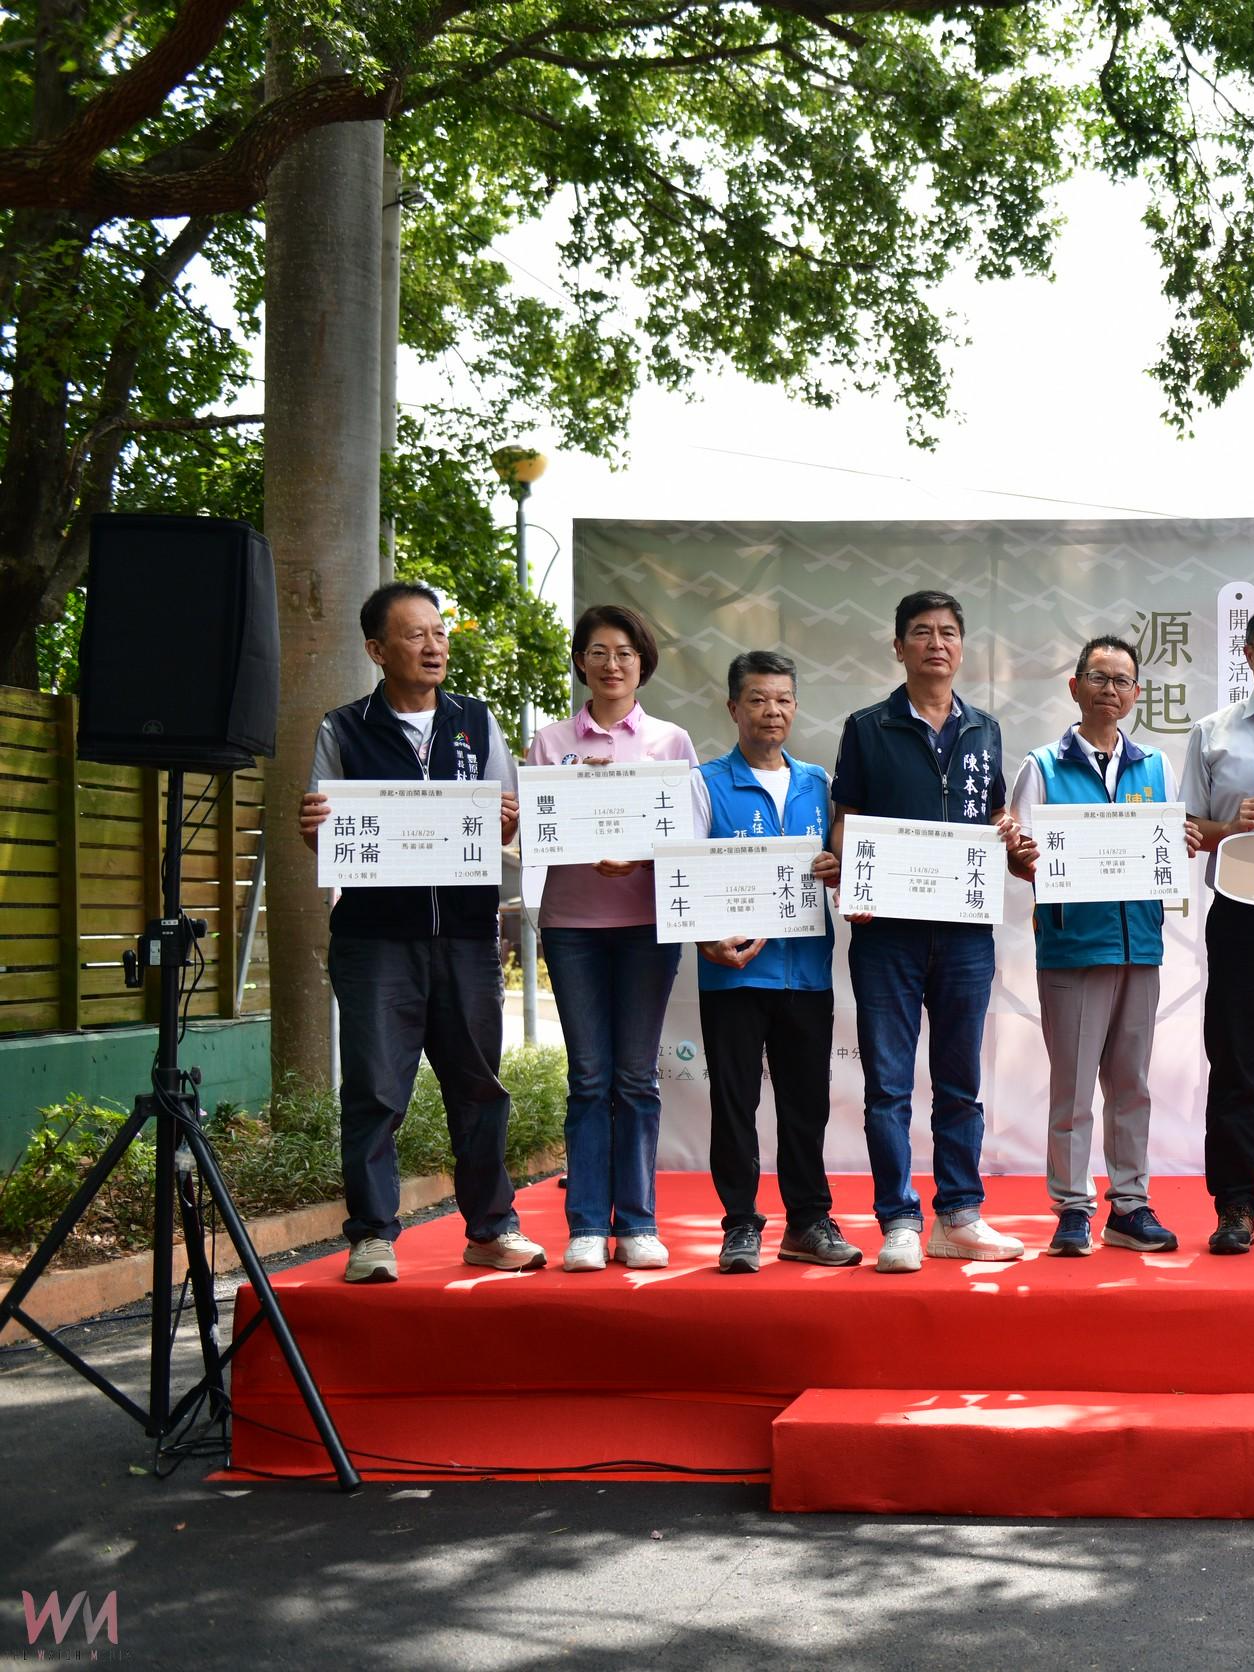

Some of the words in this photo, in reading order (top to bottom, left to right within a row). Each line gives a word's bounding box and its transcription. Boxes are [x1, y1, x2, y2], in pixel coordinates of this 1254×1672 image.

[1131, 611, 1192, 735] 源起
[1228, 609, 1249, 703] 開幕活動
[963, 753, 980, 818] 陳本添
[980, 749, 991, 816] 臺中市議員
[462, 815, 484, 863] 新山
[537, 795, 558, 843] 豐原
[653, 790, 676, 837] 土牛
[752, 810, 764, 834] 主任
[359, 815, 381, 864] 馬崙
[1046, 831, 1066, 877] 新山
[1152, 825, 1172, 885] 久良栖
[669, 869, 691, 917] 土牛
[777, 865, 797, 919] 貯木池
[800, 873, 818, 909] 豐原
[853, 839, 876, 902] 麻竹坑
[965, 847, 987, 910] 貯木場
